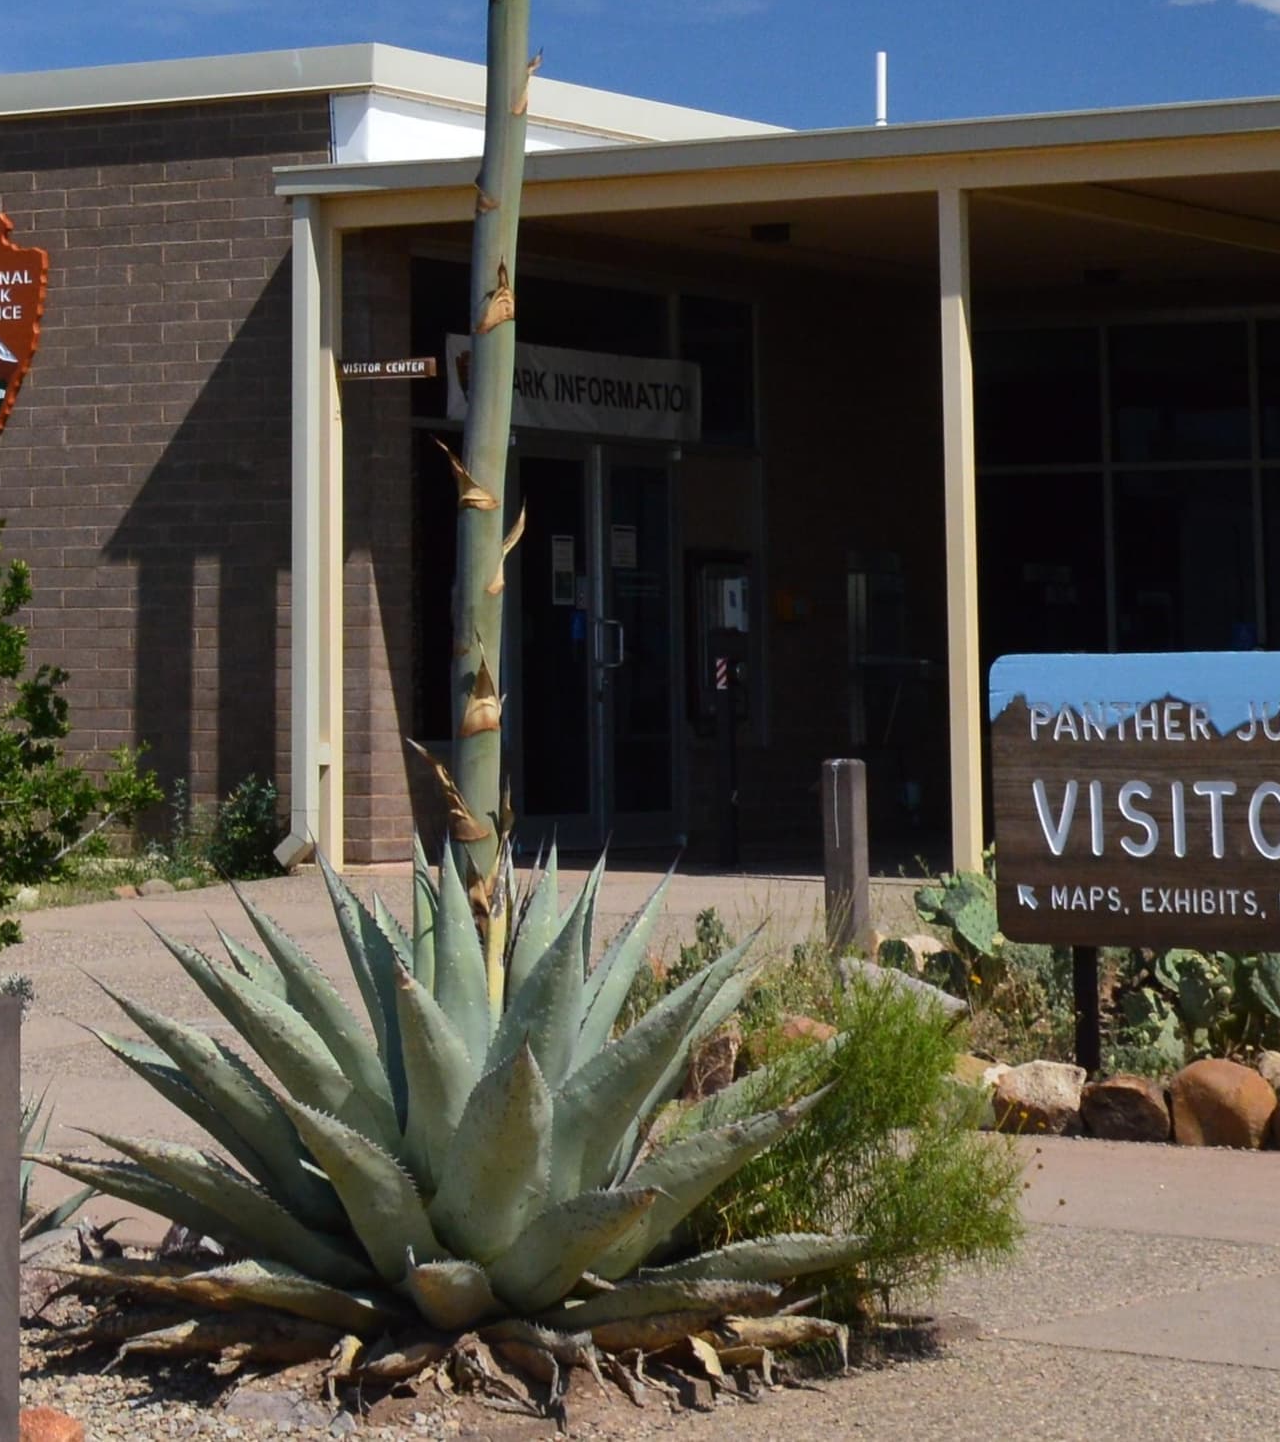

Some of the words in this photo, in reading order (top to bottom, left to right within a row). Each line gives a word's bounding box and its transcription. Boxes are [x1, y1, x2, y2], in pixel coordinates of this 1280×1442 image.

[343, 362, 381, 375] VISITOR
[386, 361, 425, 373] CENTER
[513, 366, 549, 401] ARK
[1028, 701, 1212, 742] PANTHER
[1051, 884, 1130, 916] MAPS,
[1141, 886, 1267, 920] EXHIBITS,
